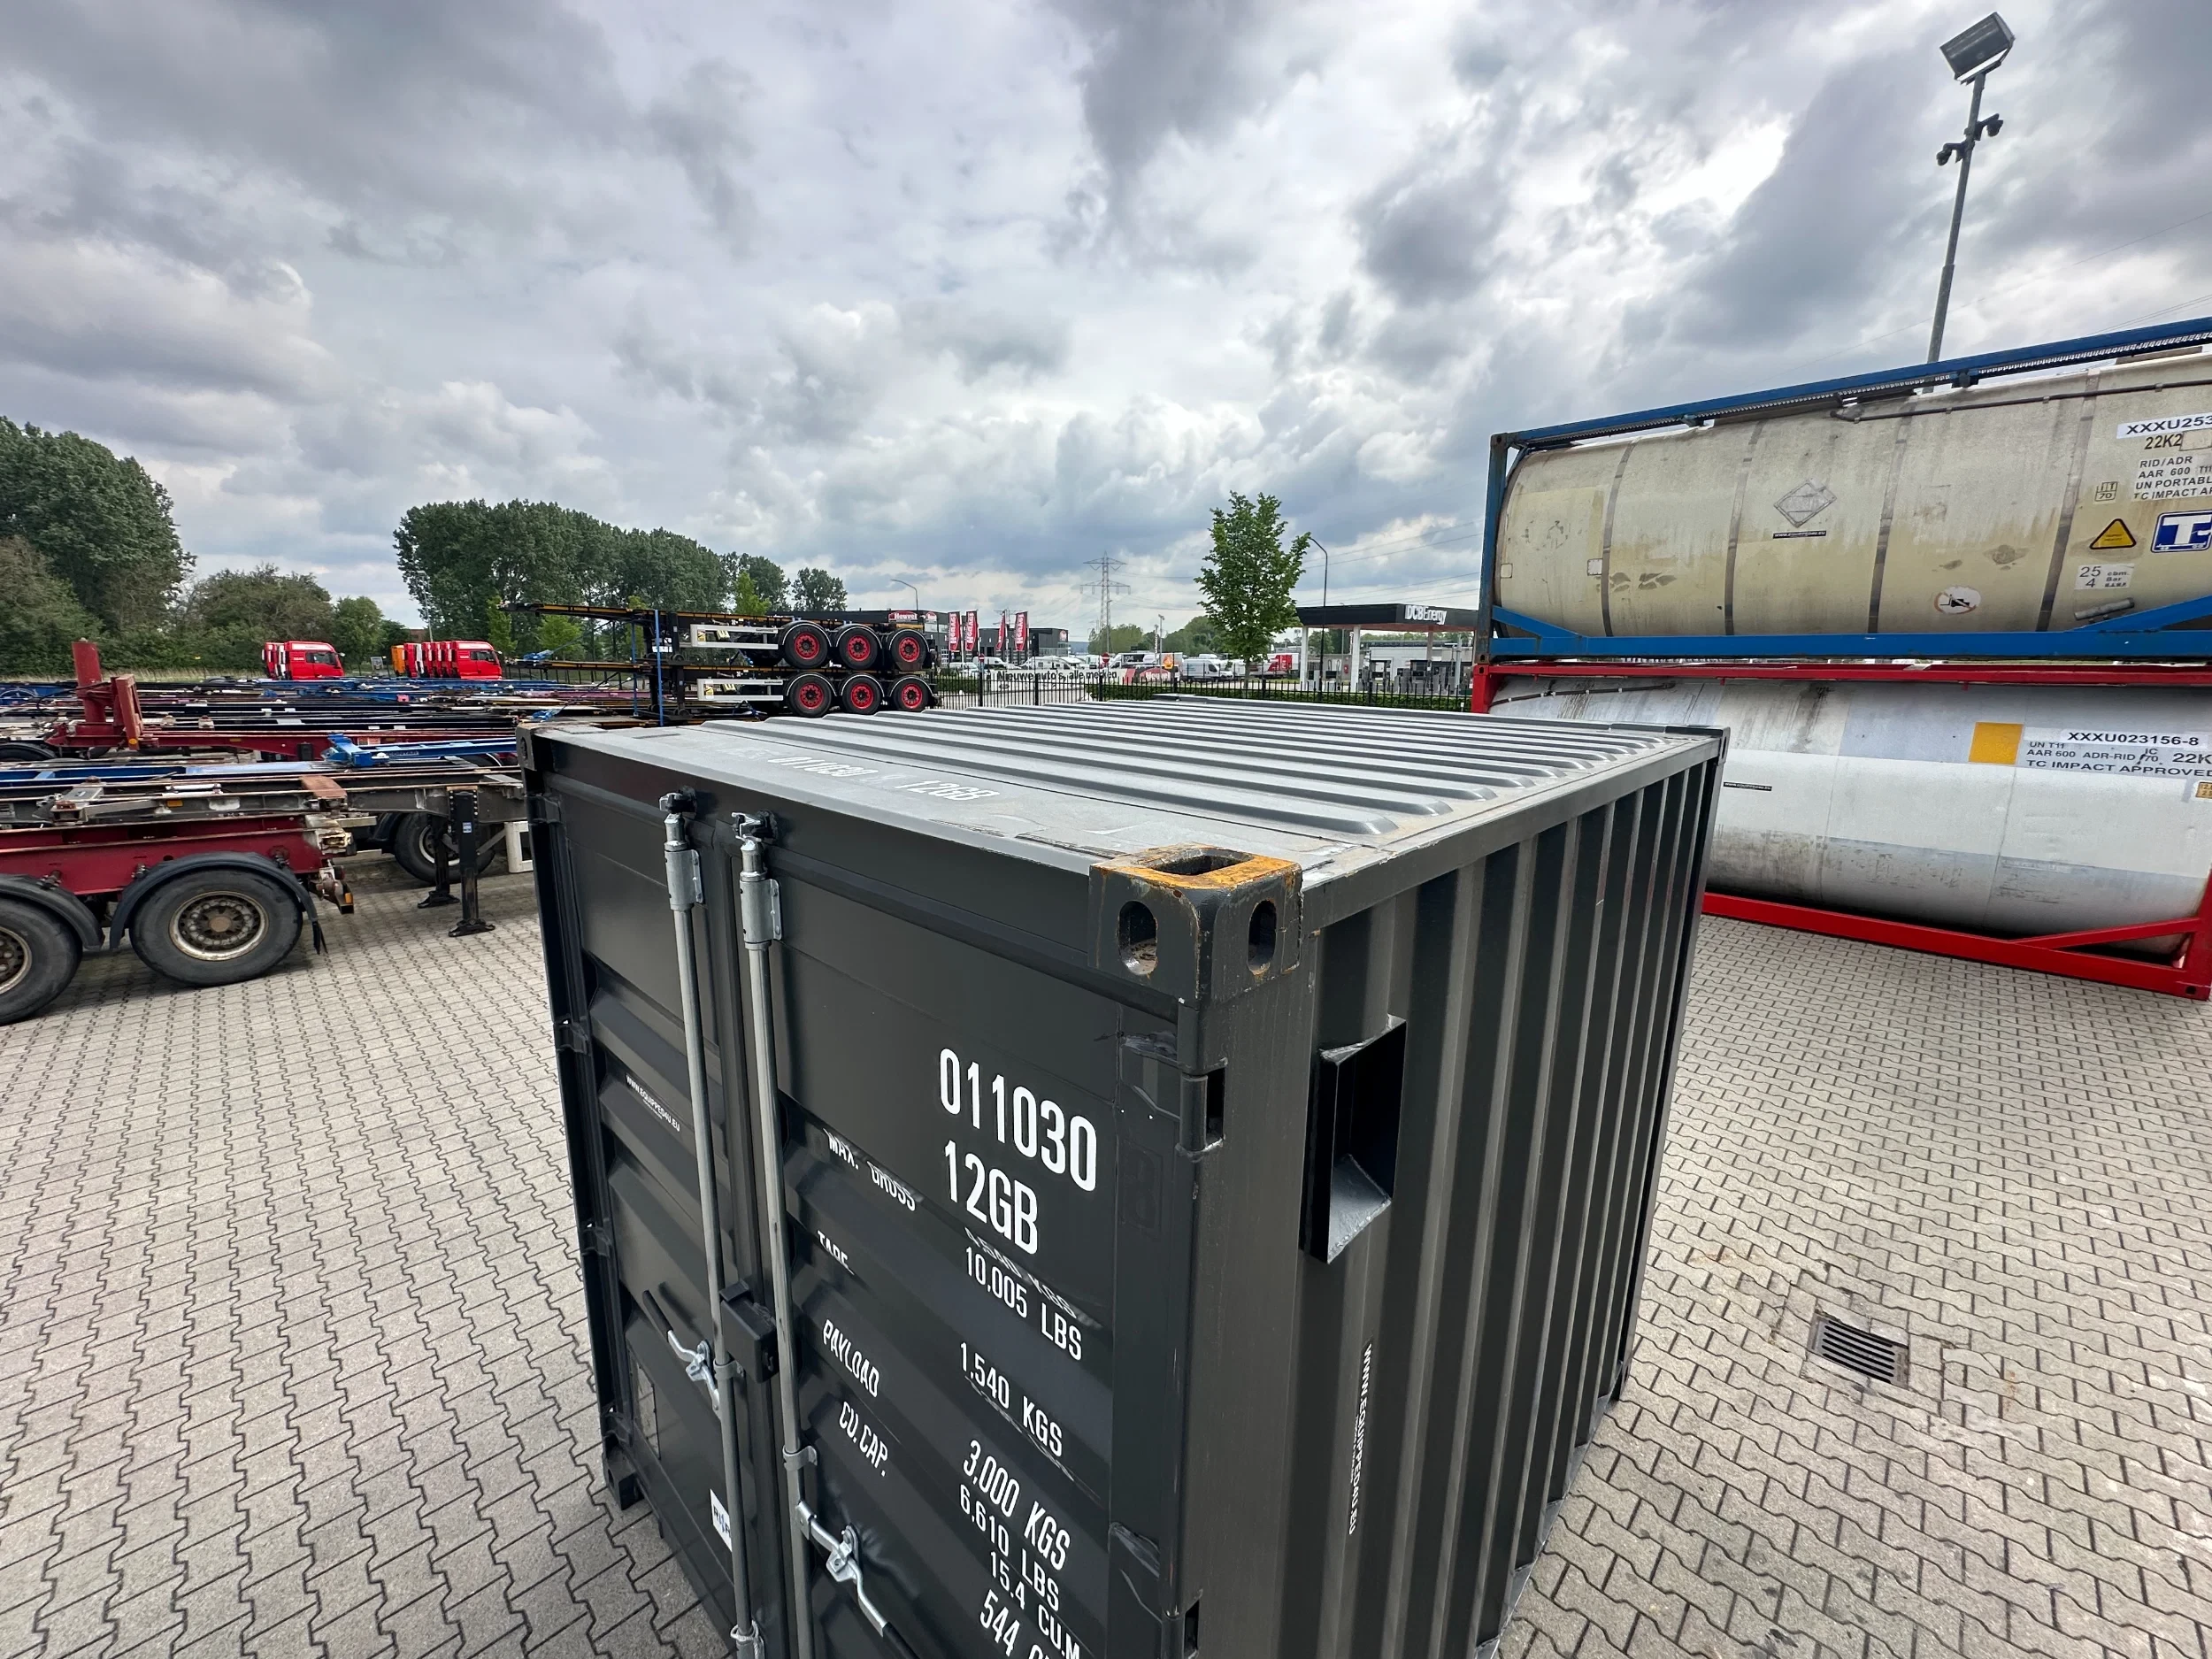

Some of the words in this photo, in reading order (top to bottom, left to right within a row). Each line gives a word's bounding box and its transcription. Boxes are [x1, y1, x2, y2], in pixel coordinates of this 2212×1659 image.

[2144, 433, 2183, 449] 22K2
[2139, 456, 2193, 469] RID/ADR
[2138, 469, 2164, 479] AAR
[2170, 466, 2191, 476] 600
[2135, 480, 2153, 490] UN
[2152, 488, 2198, 499] IMPACT
[2079, 565, 2102, 578] 25
[2085, 578, 2096, 588] 4
[997, 670, 1033, 681] Nieuwe
[1069, 670, 1084, 680] alle
[2067, 732, 2200, 746] XXXU023156-8
[2083, 752, 2136, 761] ADR-RID
[2051, 761, 2116, 772] IMPACT
[940, 1048, 1097, 1192] 011030
[945, 1140, 1038, 1255] 12GB
[1041, 1302, 1082, 1361] LBS
[823, 1319, 879, 1398] PAYLOAD
[1023, 1395, 1063, 1457] KGS
[1024, 1501, 1071, 1571] KGS
[1021, 1548, 1059, 1612] LBS
[979, 1589, 1020, 1657] 544
